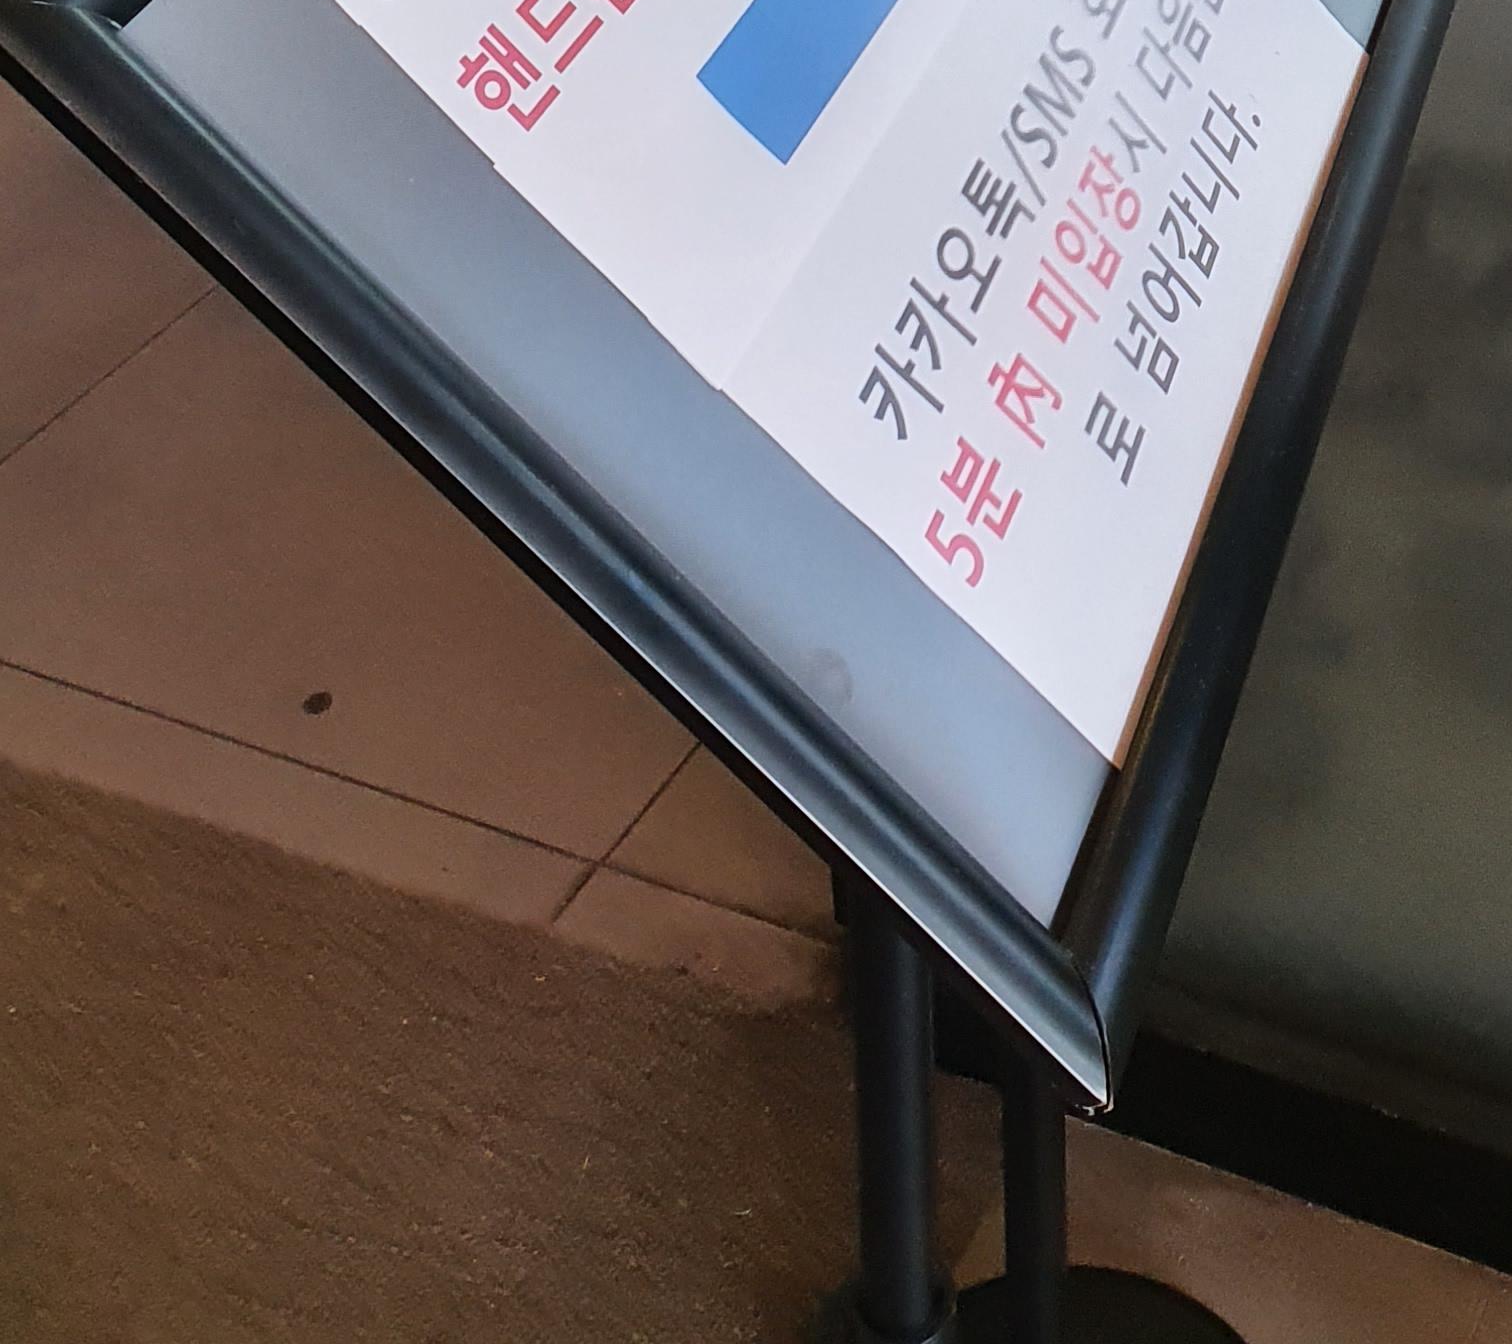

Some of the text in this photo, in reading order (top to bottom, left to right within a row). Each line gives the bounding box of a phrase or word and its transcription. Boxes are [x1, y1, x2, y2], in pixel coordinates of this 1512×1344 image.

[858, 25, 1096, 442] 카카오톡/SMS
[1084, 90, 1263, 487] 로 넘어갑니다.
[924, 434, 1024, 589] 5분
